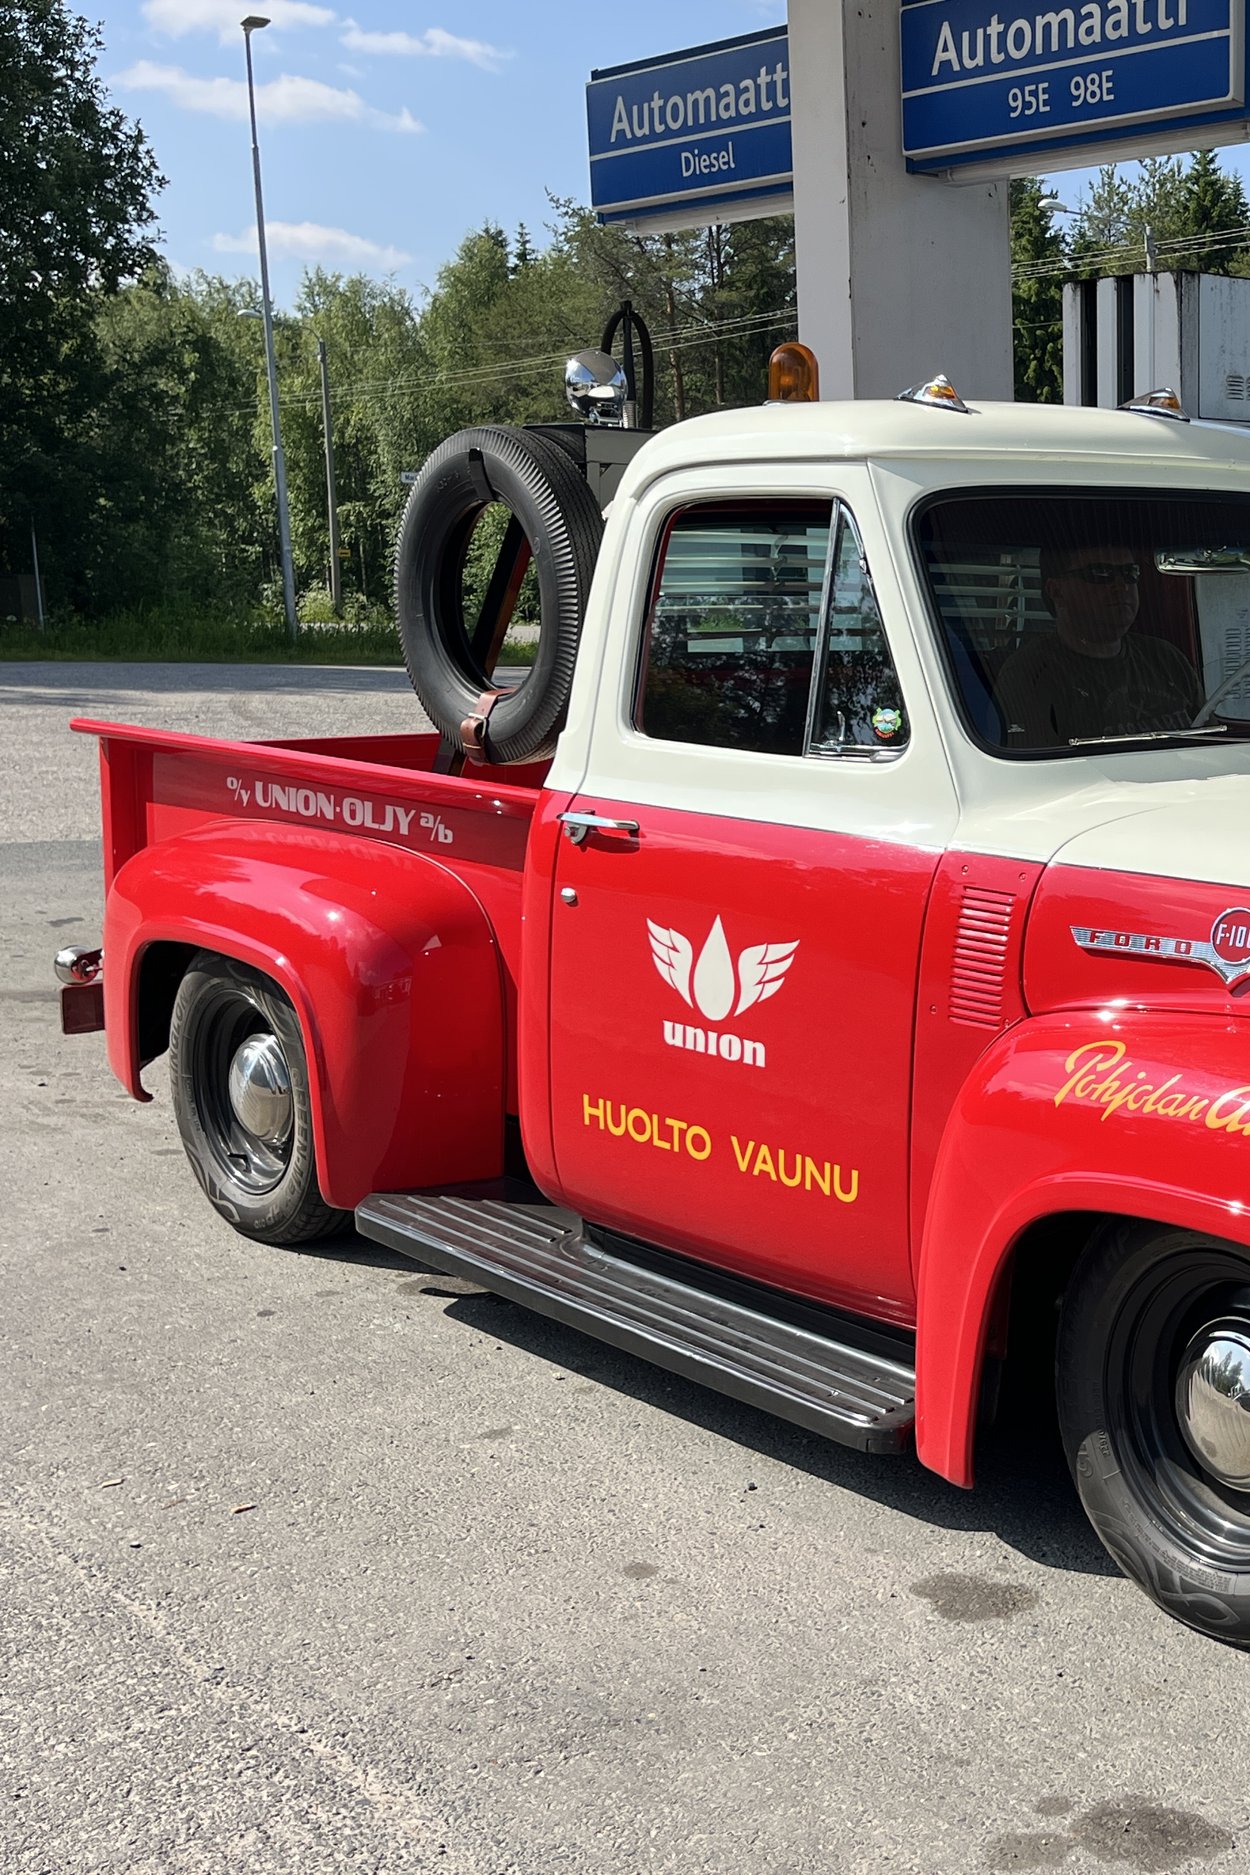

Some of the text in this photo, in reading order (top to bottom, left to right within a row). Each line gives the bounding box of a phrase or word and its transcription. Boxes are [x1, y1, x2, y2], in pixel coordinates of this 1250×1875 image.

[609, 62, 789, 143] Automaatt
[1008, 69, 1114, 118] 95E 98E
[681, 141, 735, 177] Diesel
[1088, 930, 1193, 955] FORD
[662, 1019, 766, 1068] union
[1054, 1040, 1209, 1122] Pohjolan
[582, 1093, 859, 1203] HUOLTO VAUNU
